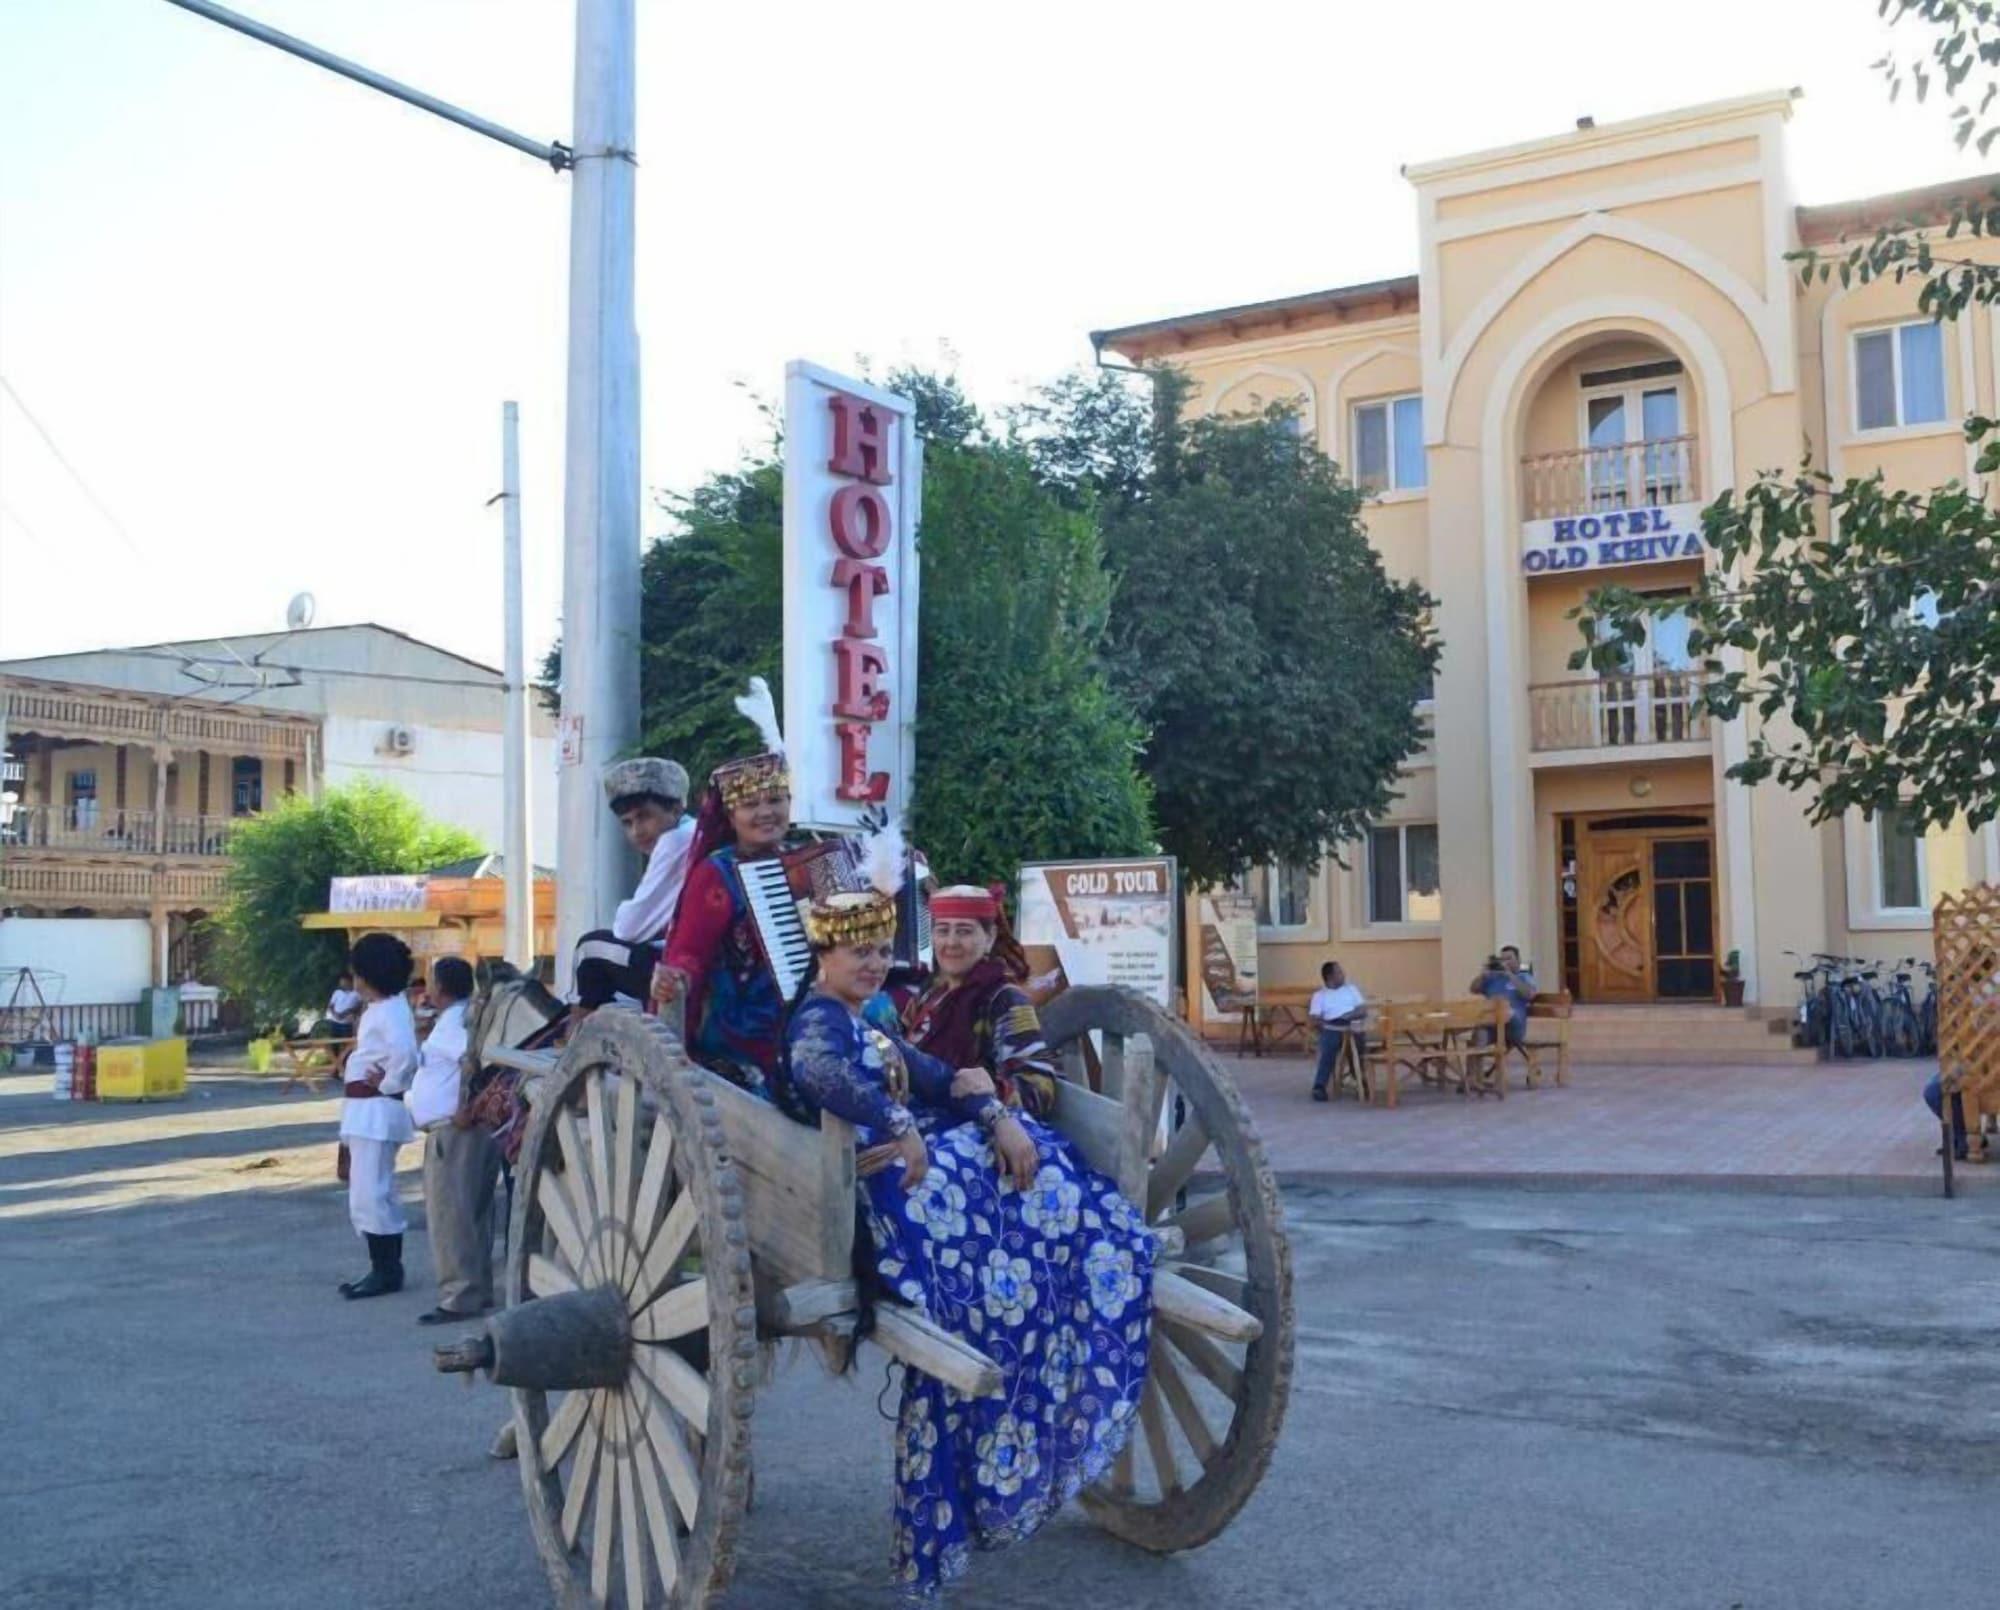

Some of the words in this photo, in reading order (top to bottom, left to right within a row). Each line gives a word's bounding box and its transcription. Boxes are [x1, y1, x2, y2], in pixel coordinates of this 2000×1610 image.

[1554, 509, 1671, 542] HOTEL
[1525, 546, 1588, 572] OLD
[1598, 533, 1704, 565] KHIVA
[828, 393, 893, 802] HOTEL
[1114, 870, 1159, 893] TOUR
